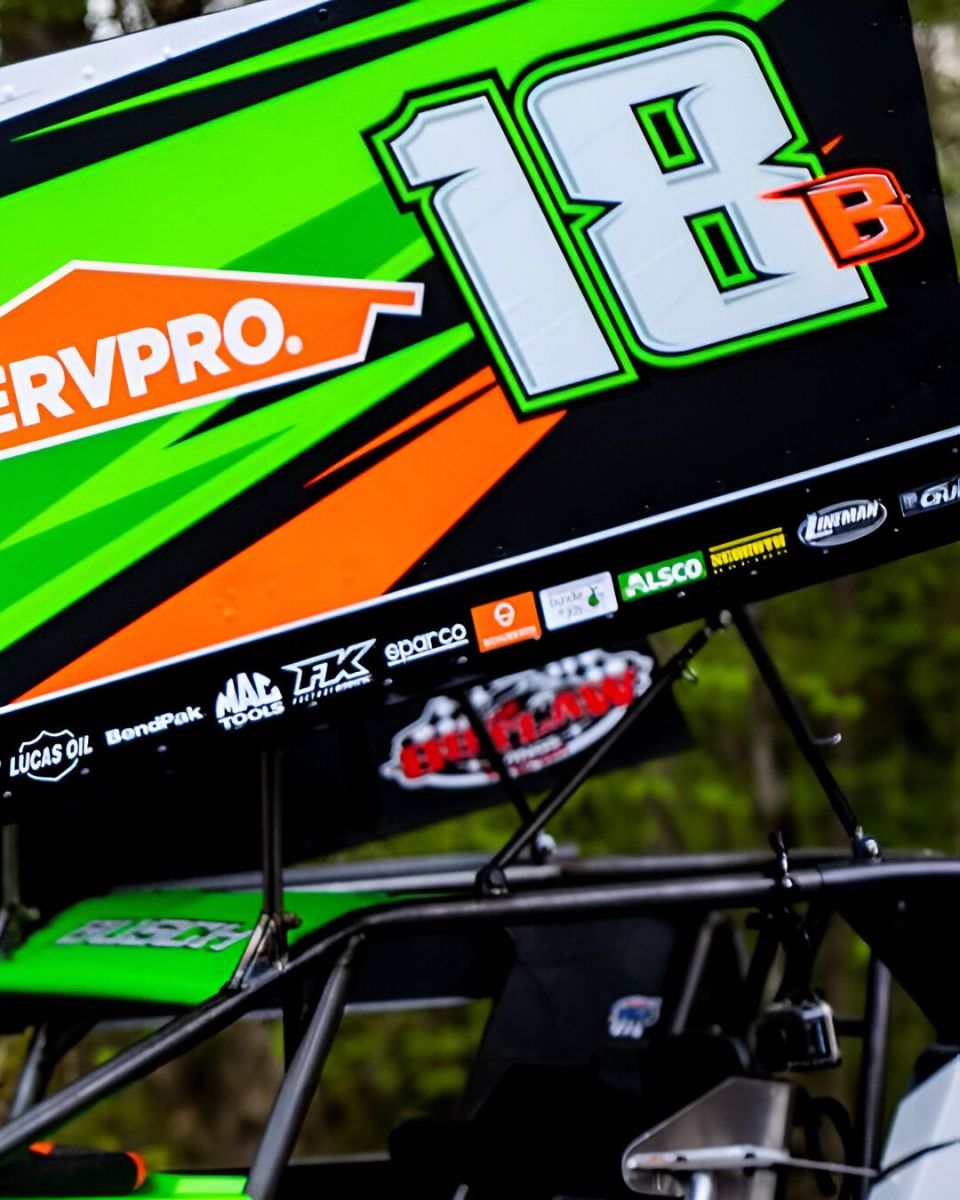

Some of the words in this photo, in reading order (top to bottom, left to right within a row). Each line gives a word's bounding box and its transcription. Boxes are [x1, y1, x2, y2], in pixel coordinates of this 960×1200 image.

[625, 557, 703, 598] ALSCO
[385, 623, 469, 668] sparco
[216, 672, 283, 720] MAC
[218, 701, 286, 731] TOOLS
[105, 705, 204, 746] BendPak
[9, 745, 63, 778] LUCAS
[66, 736, 94, 761] OIL
